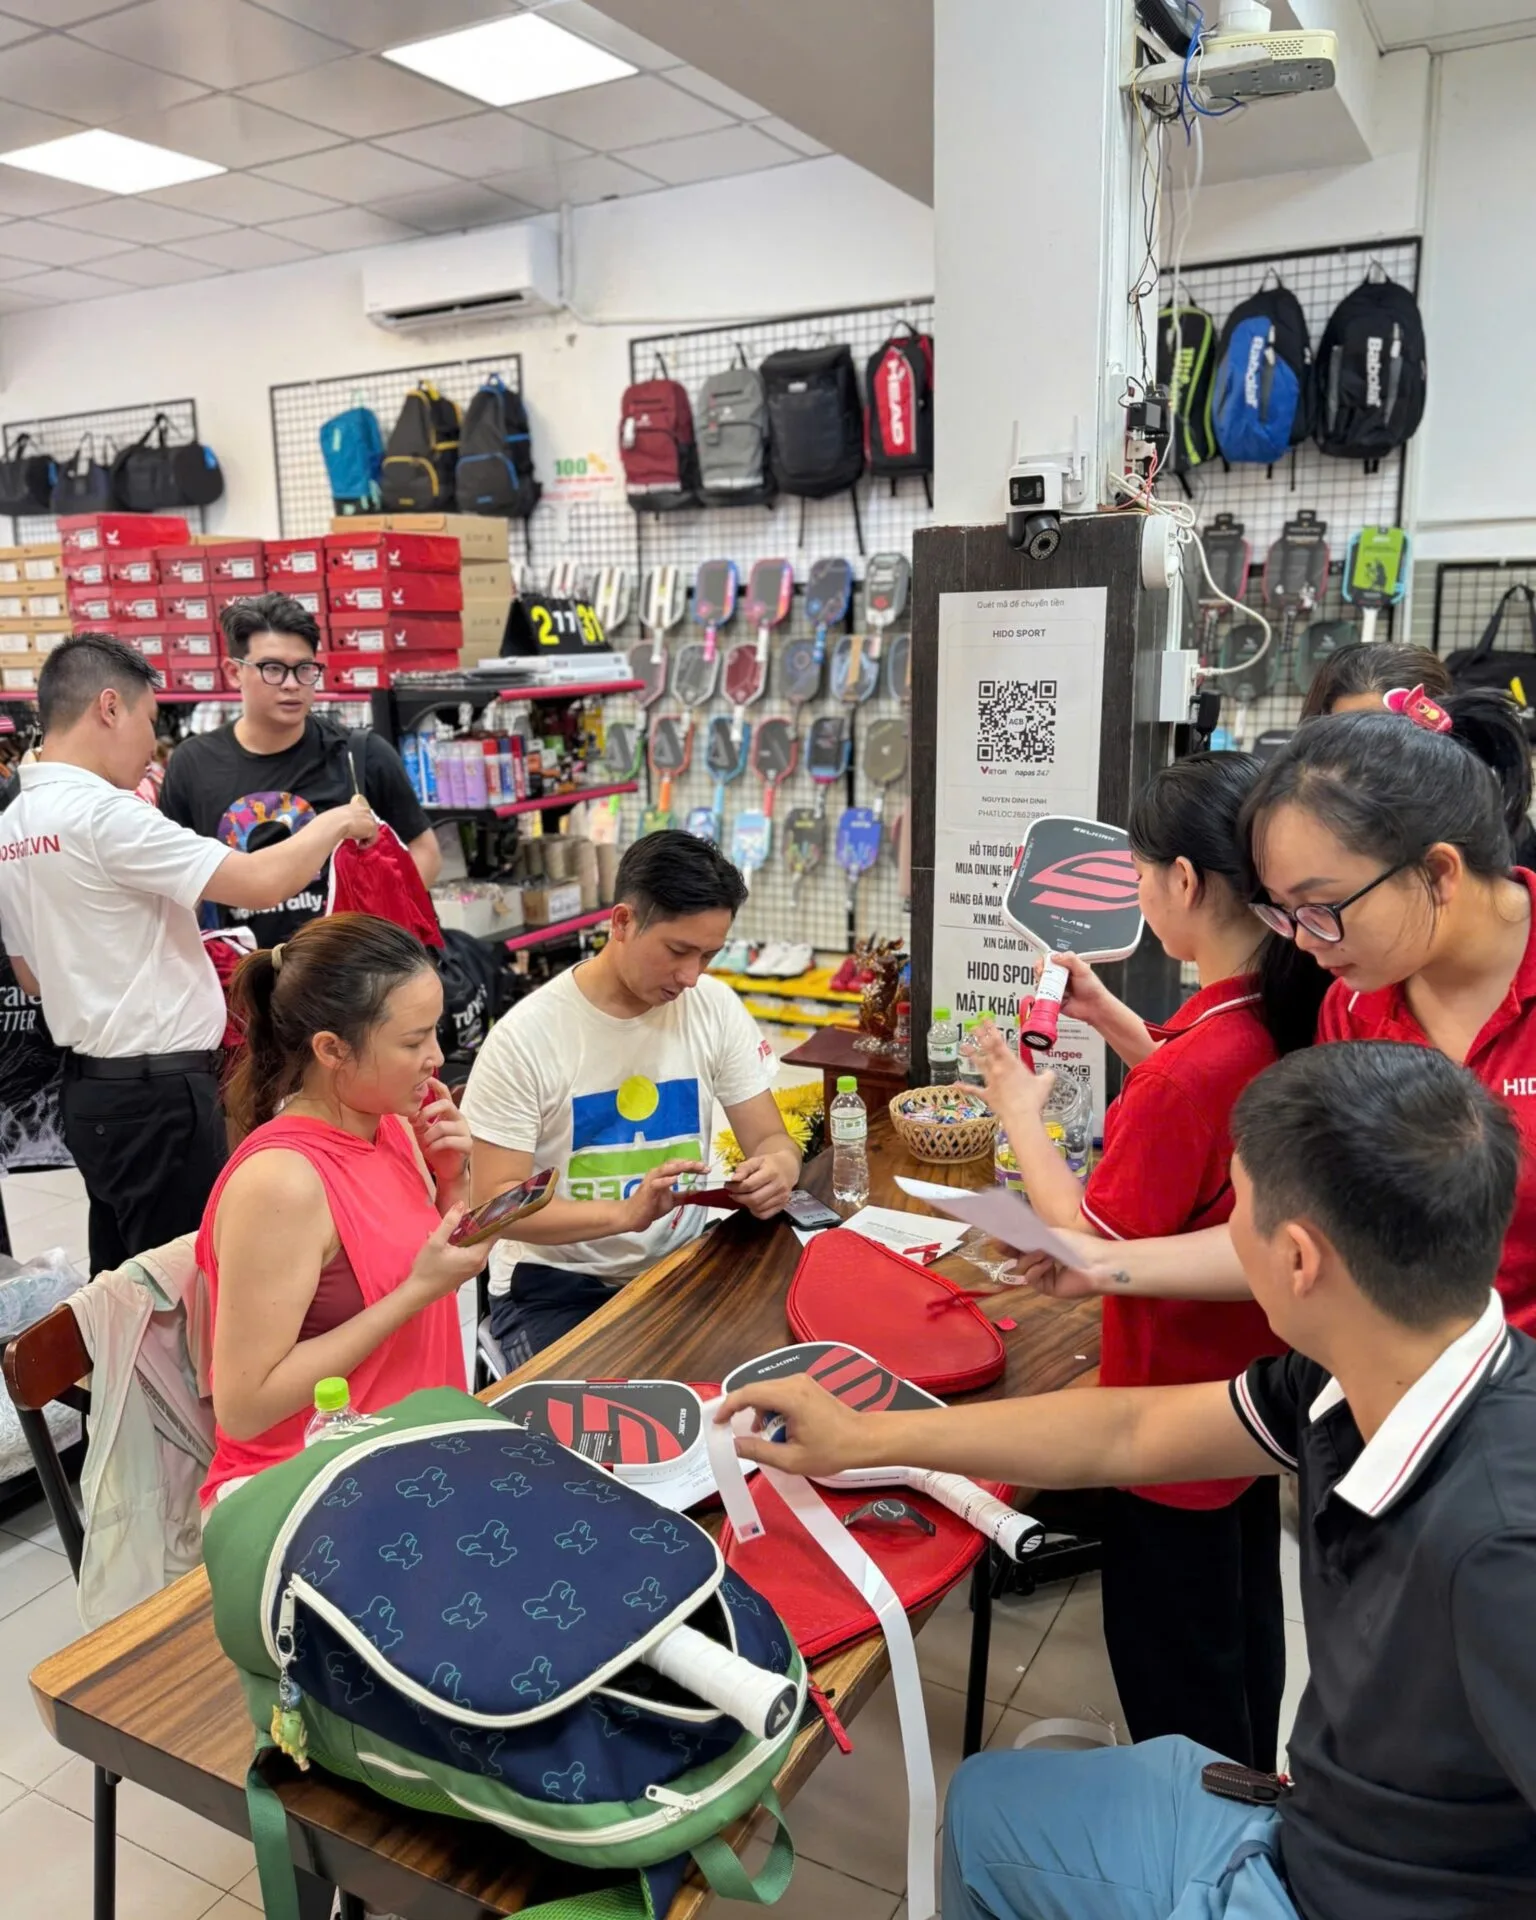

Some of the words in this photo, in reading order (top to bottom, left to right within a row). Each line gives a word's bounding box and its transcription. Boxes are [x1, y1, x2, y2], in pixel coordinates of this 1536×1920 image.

[1366, 336, 1383, 408] Babolat
[887, 358, 907, 446] HEAD
[992, 630, 1014, 638] HIDO
[1015, 628, 1046, 638] SPORT
[955, 862, 974, 874] MUA
[974, 863, 1001, 876] ONLINE
[973, 913, 986, 925] XIN
[983, 937, 996, 949] XIN
[967, 961, 999, 982] HIDO
[956, 990, 985, 1017] MẬT
